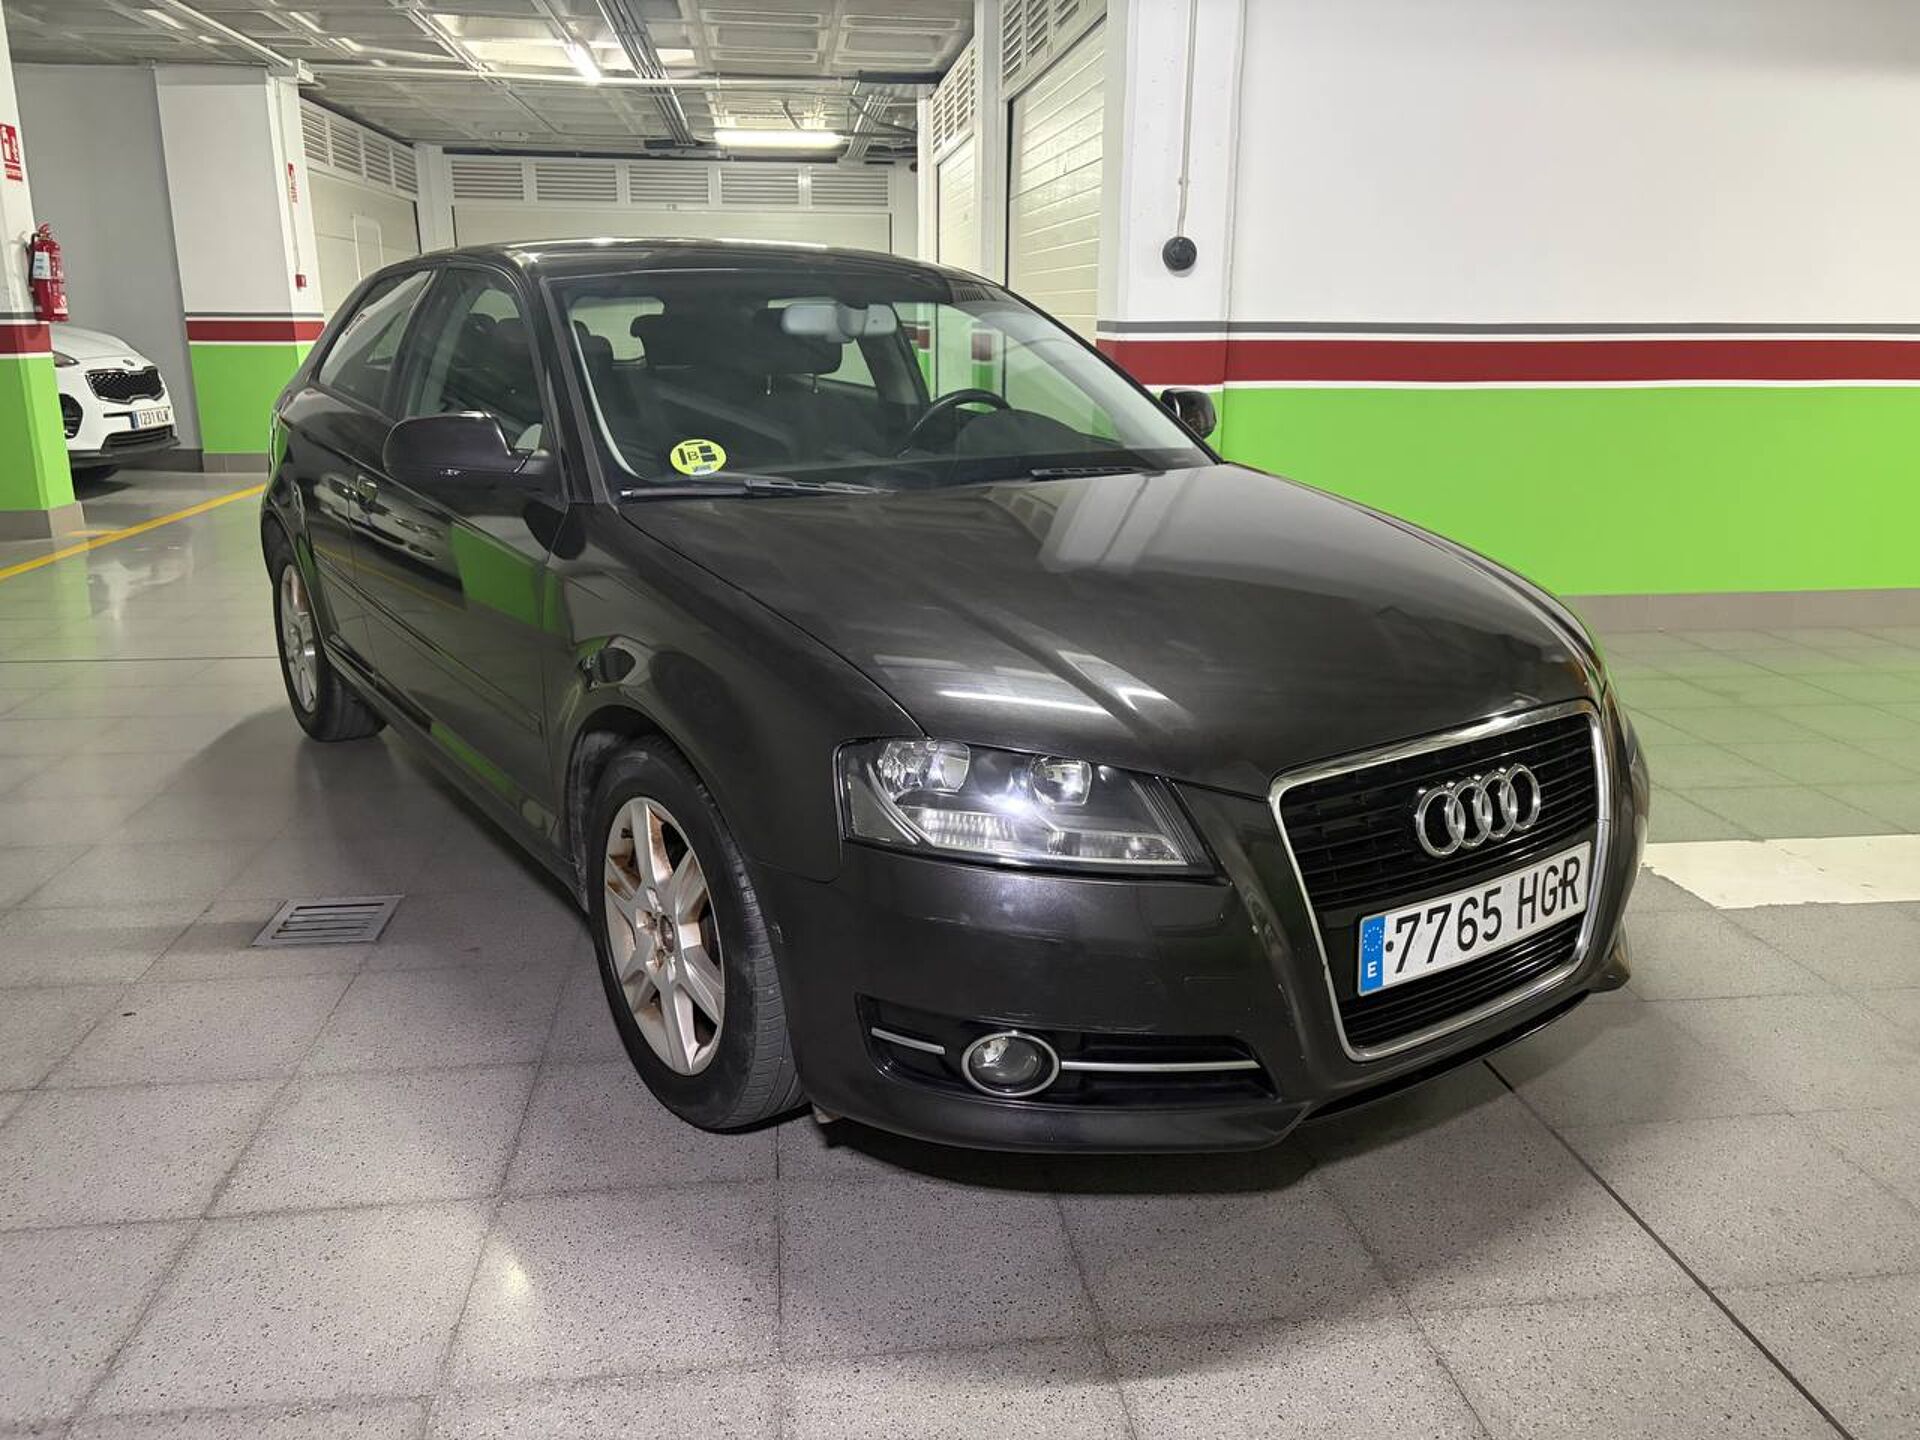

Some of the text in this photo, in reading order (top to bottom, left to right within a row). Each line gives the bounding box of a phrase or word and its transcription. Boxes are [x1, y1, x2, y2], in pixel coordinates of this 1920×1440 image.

[687, 451, 699, 461] B
[1395, 856, 1580, 974] 7765 HGR
[1367, 961, 1377, 978] E
